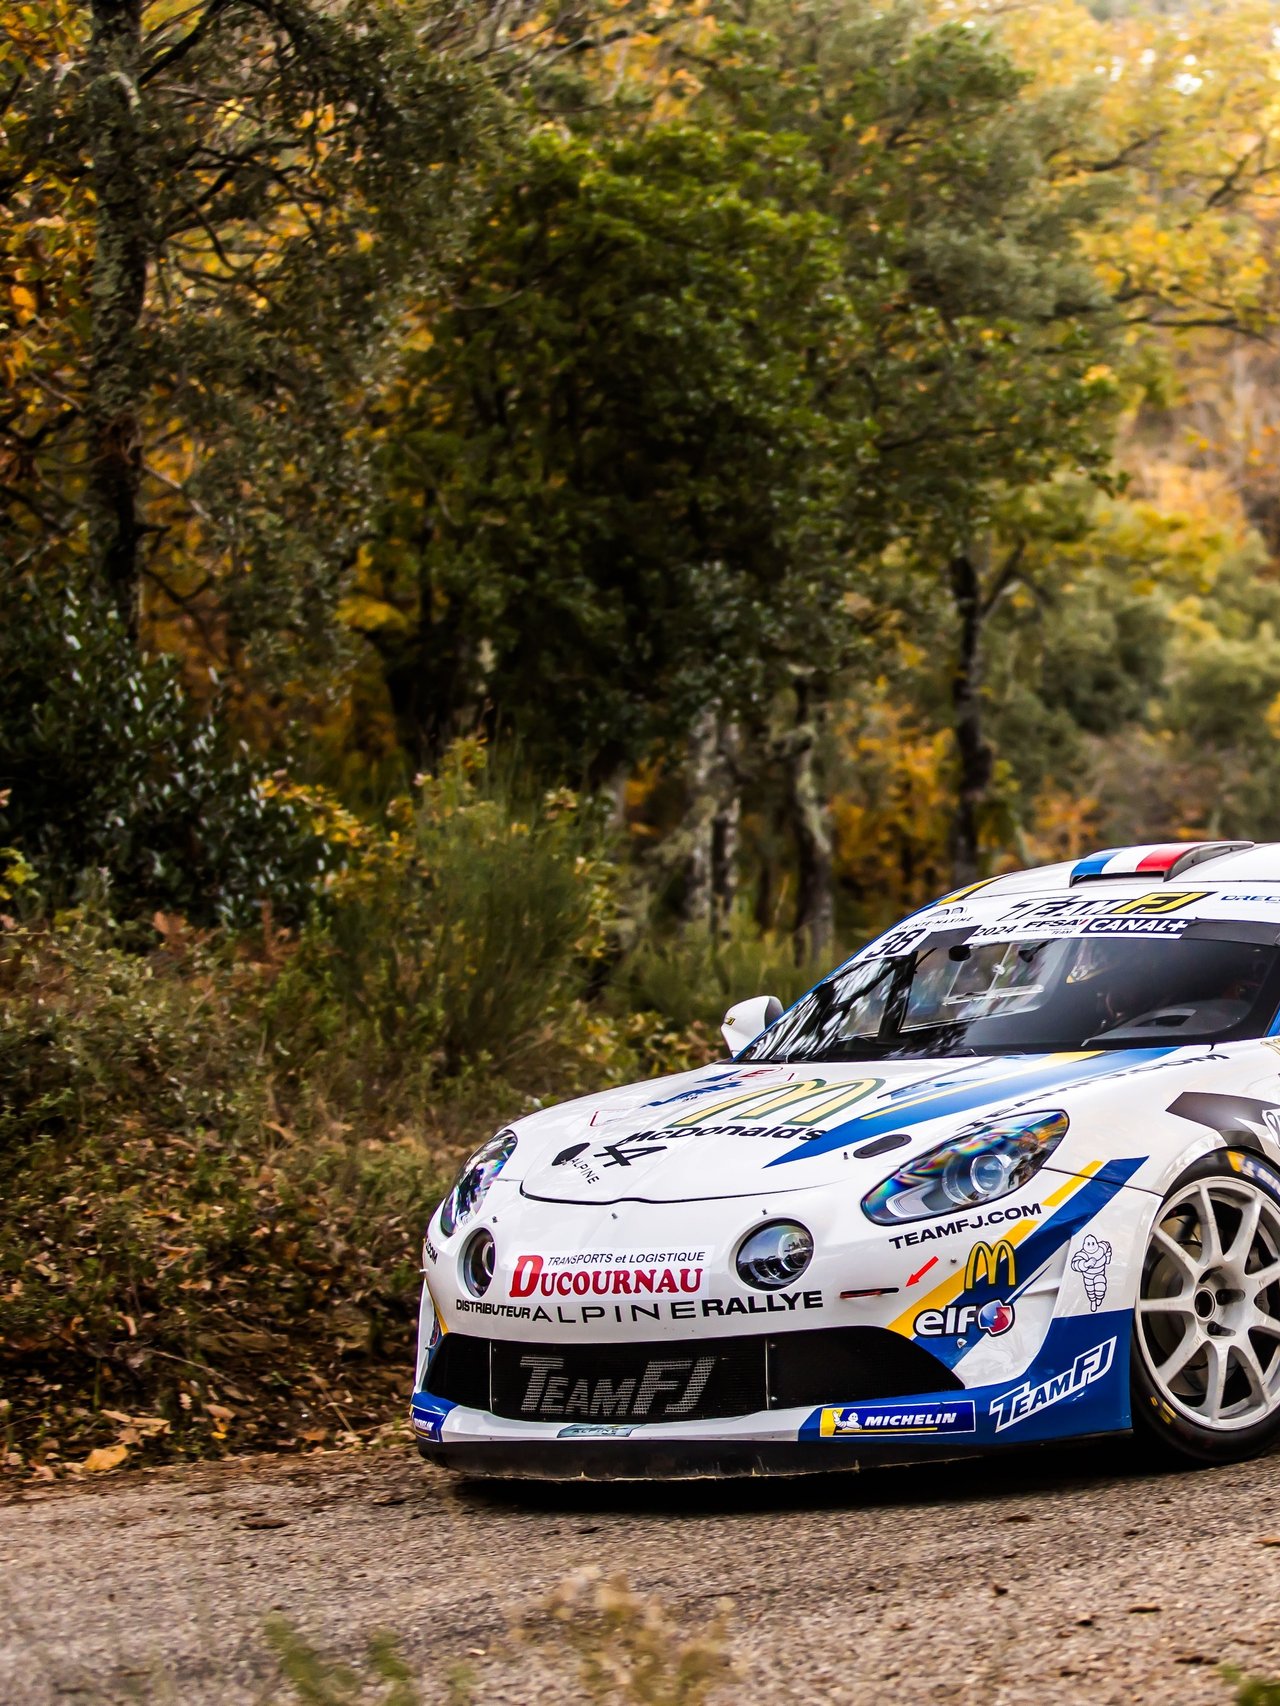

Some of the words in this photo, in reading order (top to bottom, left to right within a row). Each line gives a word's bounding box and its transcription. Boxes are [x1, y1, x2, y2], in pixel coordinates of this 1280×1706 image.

[996, 891, 1219, 922] TEAMFJ
[864, 928, 927, 957] 38
[973, 925, 1018, 937] 2024
[1088, 919, 1190, 933] CANAL+
[615, 1125, 828, 1146] McDonald's
[571, 1157, 600, 1185] ALPINE
[888, 1202, 1043, 1251] TEAMFJ.COM
[548, 1252, 613, 1266] TRANSPORTS
[615, 1253, 627, 1264] et
[629, 1251, 705, 1264] LOGISTIQUE
[509, 1254, 704, 1298] DUCOURNAU
[456, 1299, 531, 1319] DISTRIBUTEUR
[531, 1300, 697, 1323] ALPINE
[701, 1290, 824, 1317] RALLYE
[914, 1305, 978, 1336] elf
[519, 1355, 718, 1417] TEAMFJ
[988, 1335, 1118, 1434] TEAMFJ
[864, 1412, 957, 1428] MICHELIN
